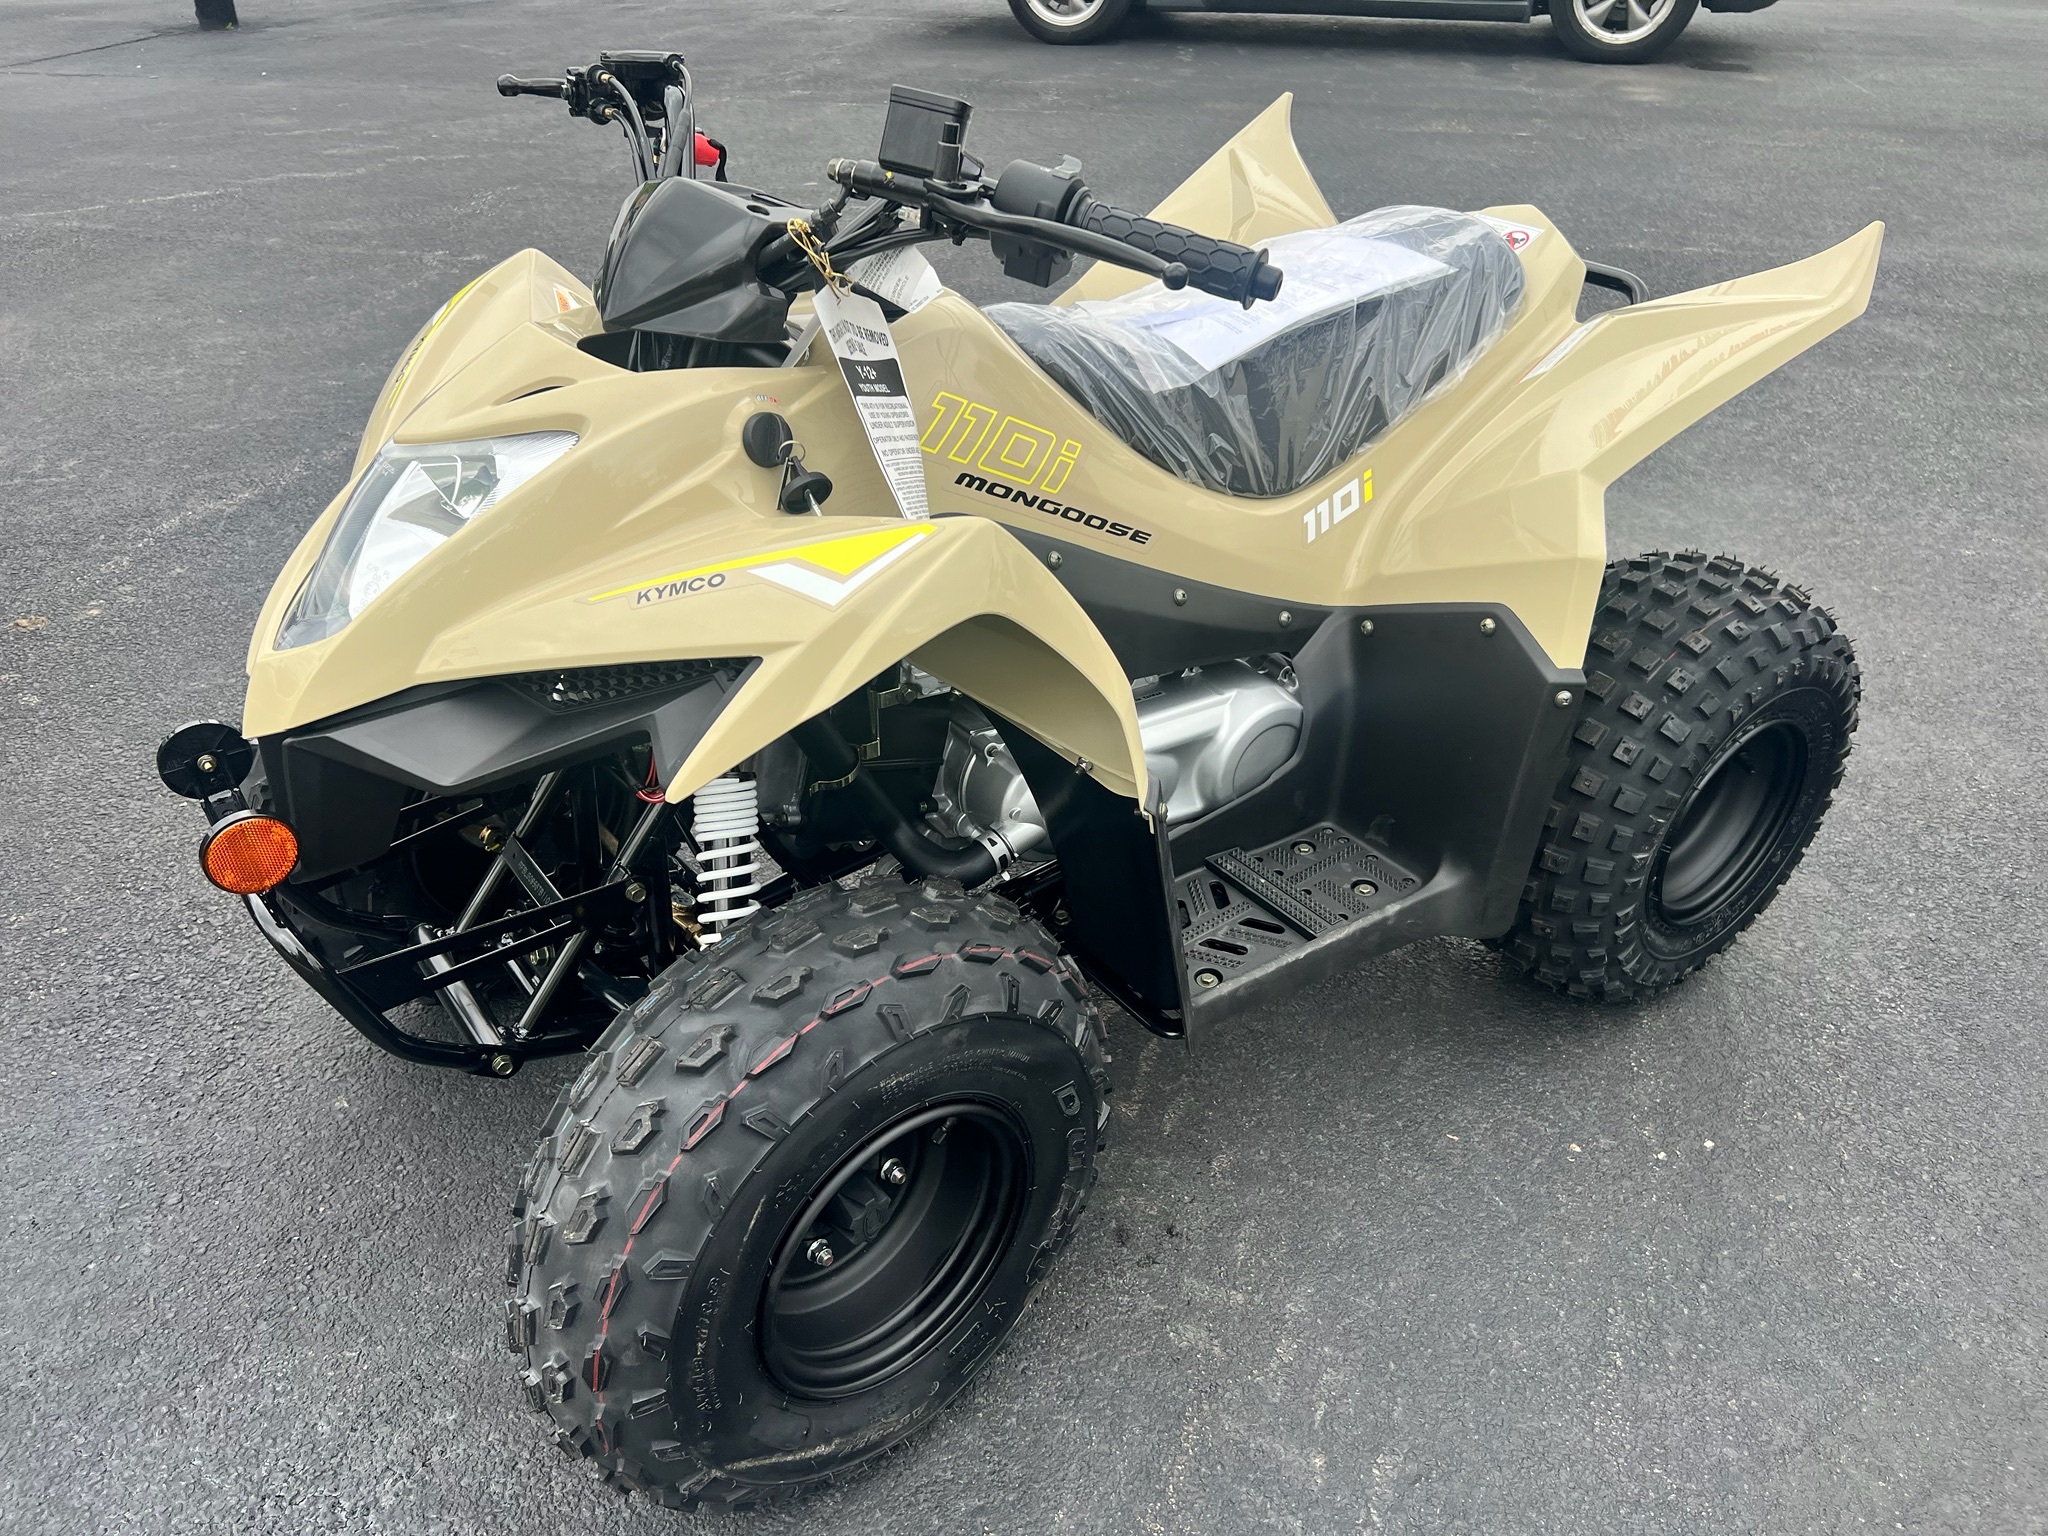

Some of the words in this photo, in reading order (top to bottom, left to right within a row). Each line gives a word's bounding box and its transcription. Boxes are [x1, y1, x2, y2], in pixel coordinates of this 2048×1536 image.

[892, 278, 902, 296] UNDER
[896, 275, 909, 298] VEHICLE
[862, 327, 889, 347] REMOVED
[858, 383, 874, 393] YOUTH
[873, 383, 891, 393] MODEL
[920, 392, 1082, 494] 110i
[954, 472, 1152, 545] MONGOOSE
[1303, 468, 1373, 544] 110i
[636, 573, 726, 604] KYMCO
